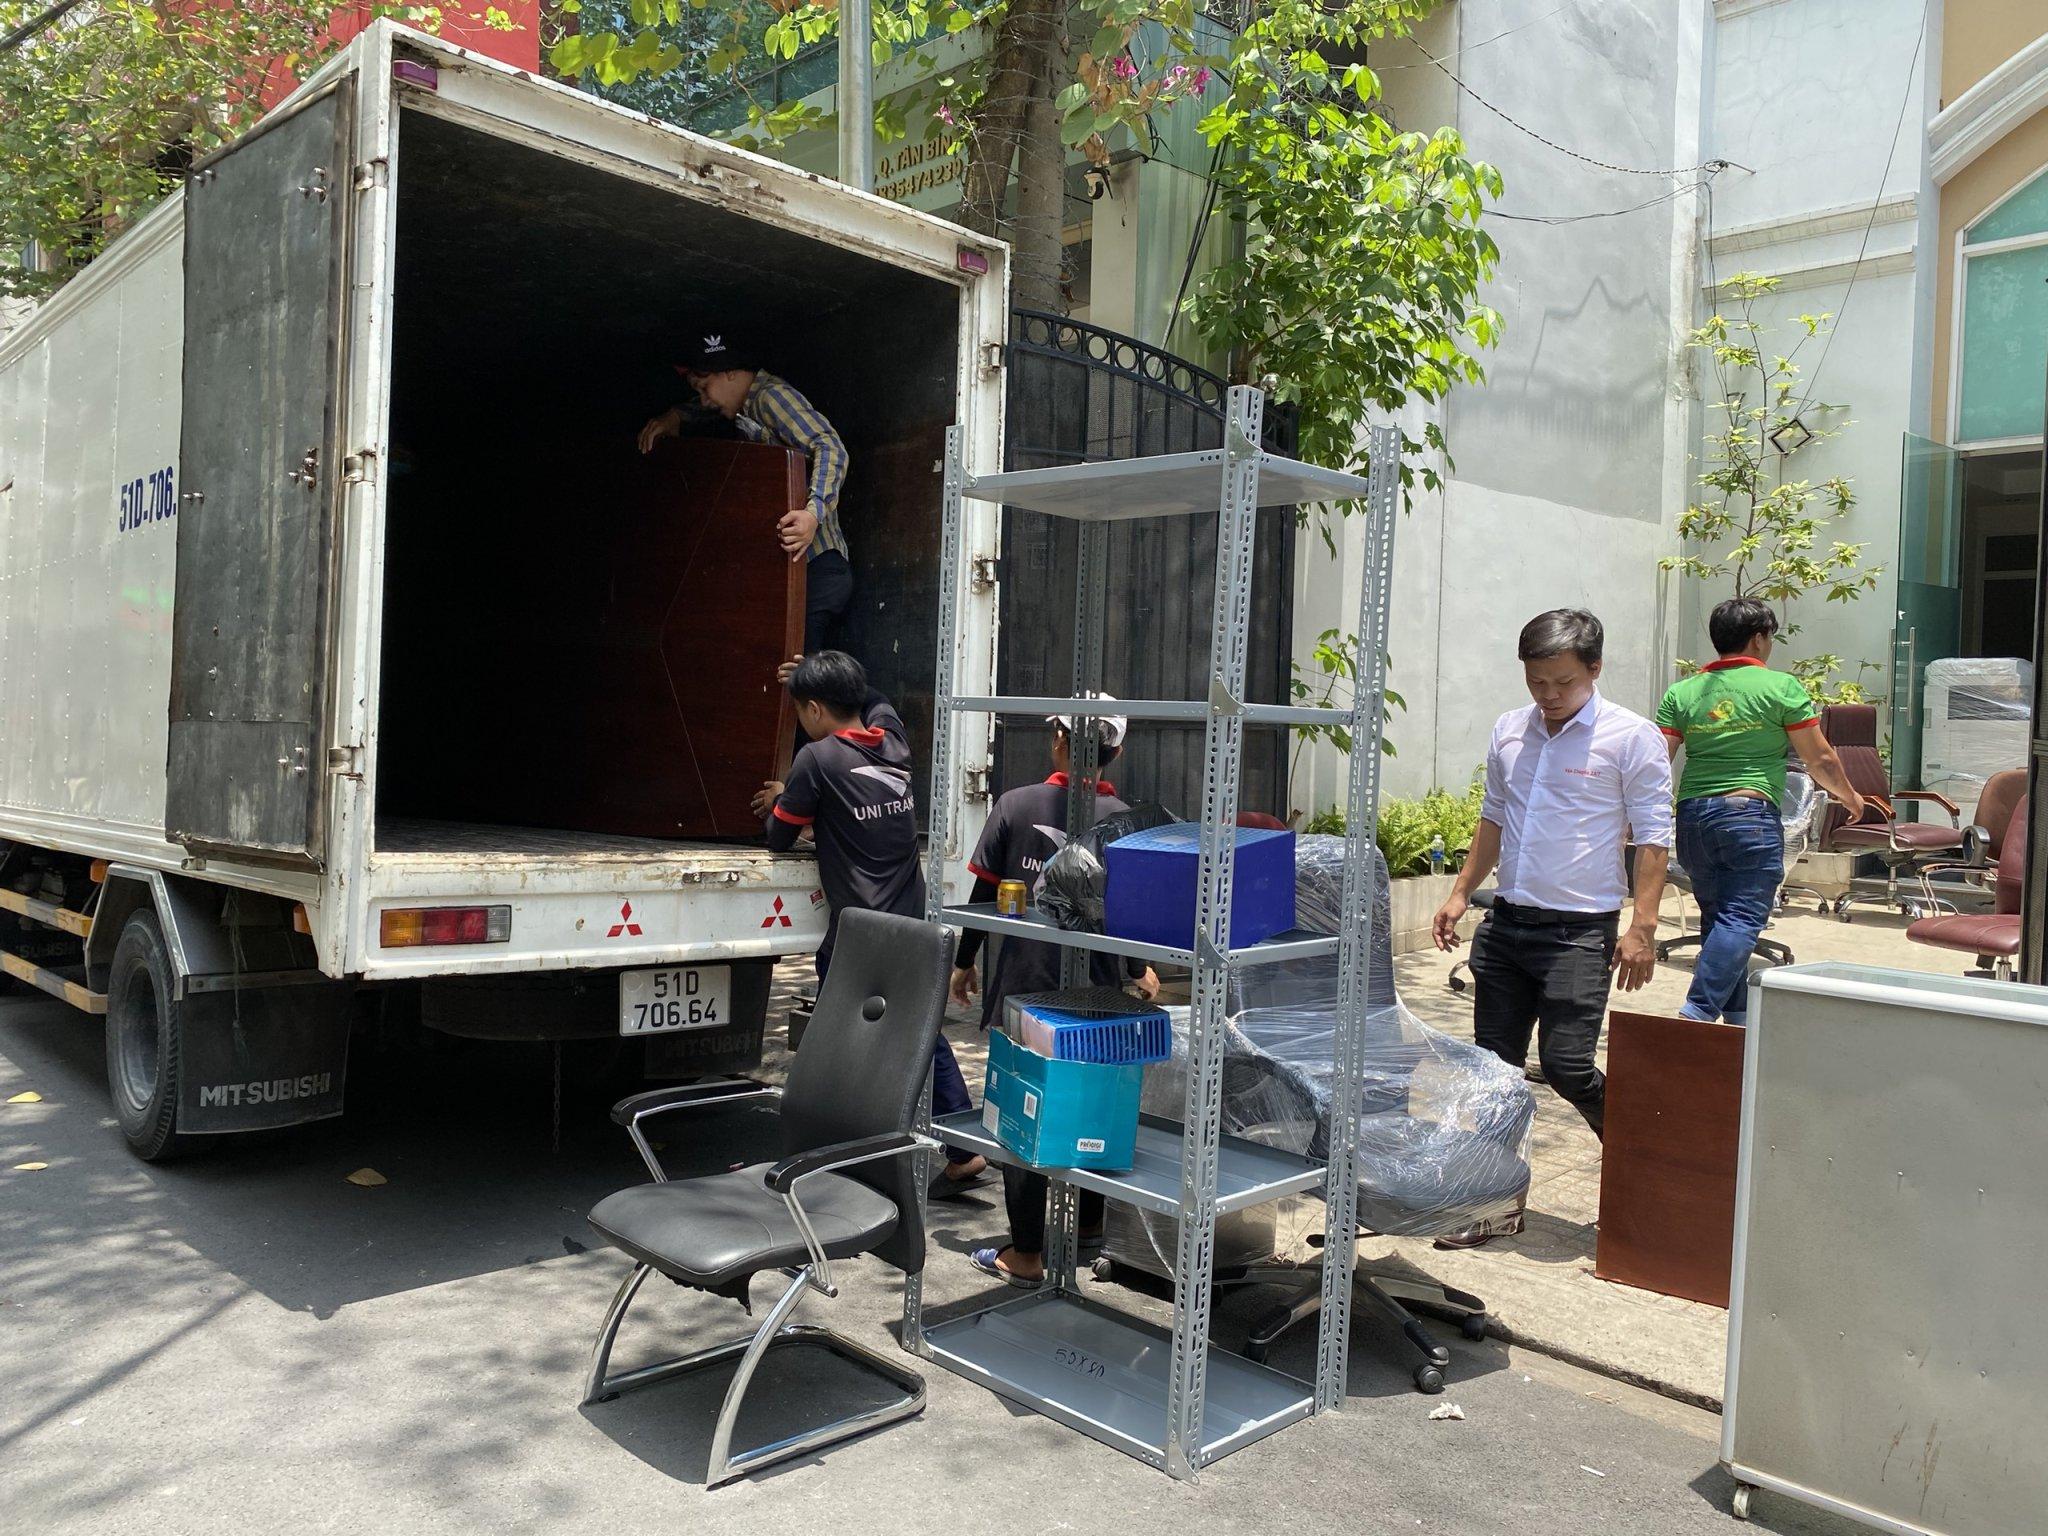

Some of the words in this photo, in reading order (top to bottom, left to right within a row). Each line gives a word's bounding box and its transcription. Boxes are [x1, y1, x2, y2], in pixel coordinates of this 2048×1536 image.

[853, 804, 882, 821] UNI
[654, 970, 699, 998] 51D
[634, 997, 717, 1030] 706.64
[199, 1072, 331, 1107] MITSUBISHI
